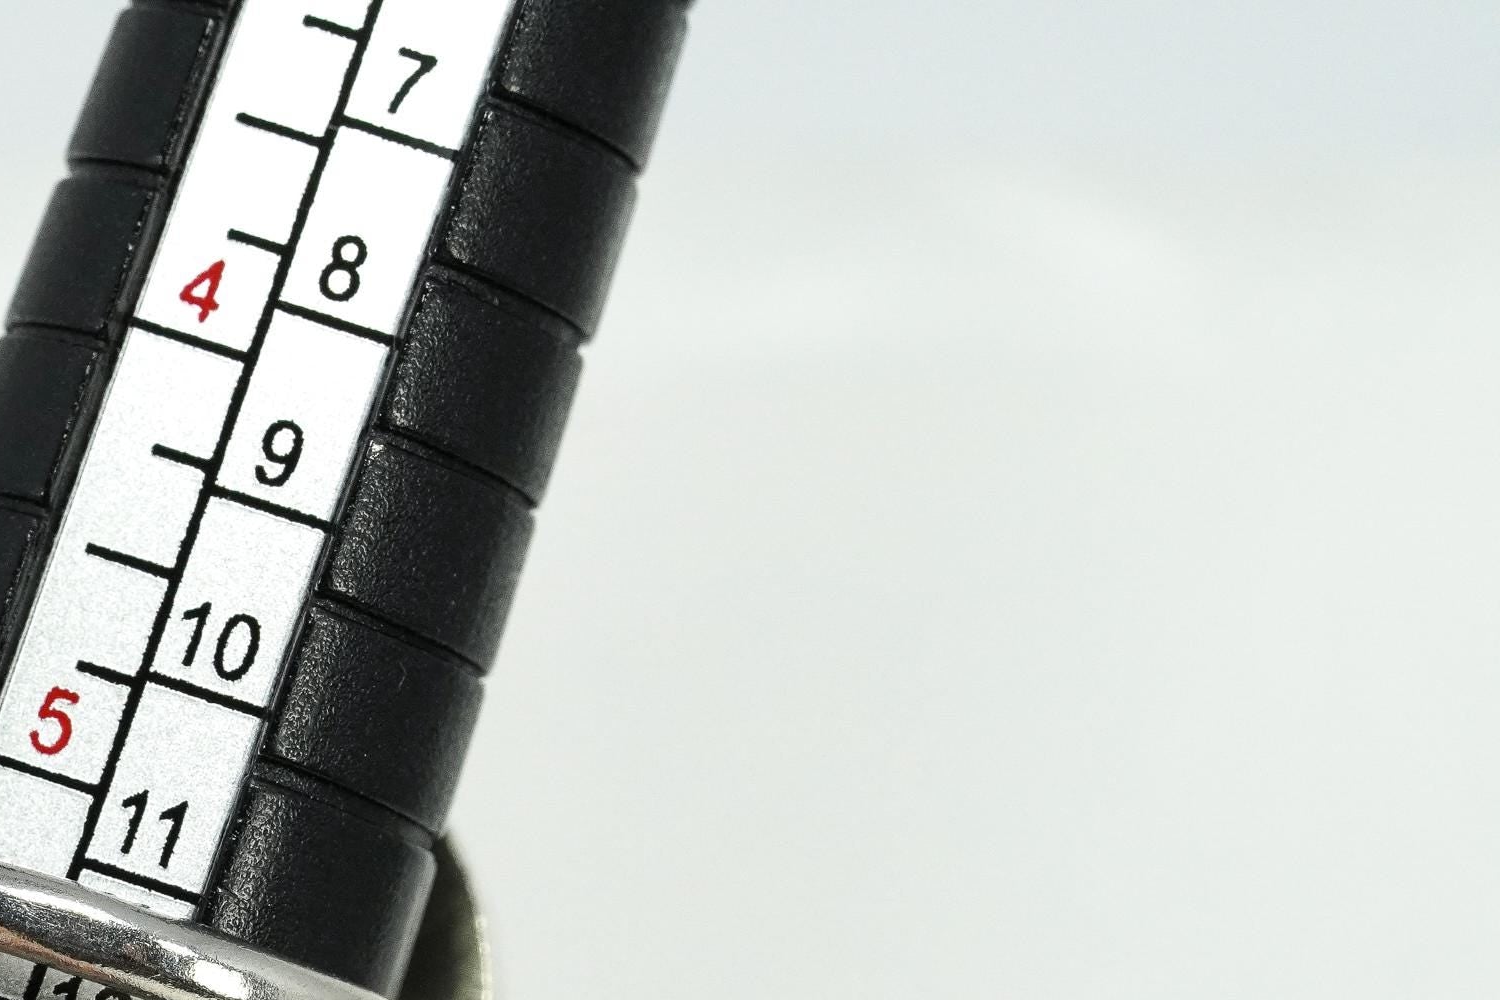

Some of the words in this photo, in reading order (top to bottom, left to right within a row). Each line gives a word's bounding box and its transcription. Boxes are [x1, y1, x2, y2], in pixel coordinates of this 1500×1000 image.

[387, 47, 438, 114] 7
[179, 260, 225, 322] 4
[318, 235, 368, 302] 8
[254, 419, 305, 487] 9
[181, 601, 262, 683] 10
[30, 687, 79, 756] 5
[120, 789, 189, 870] 11
